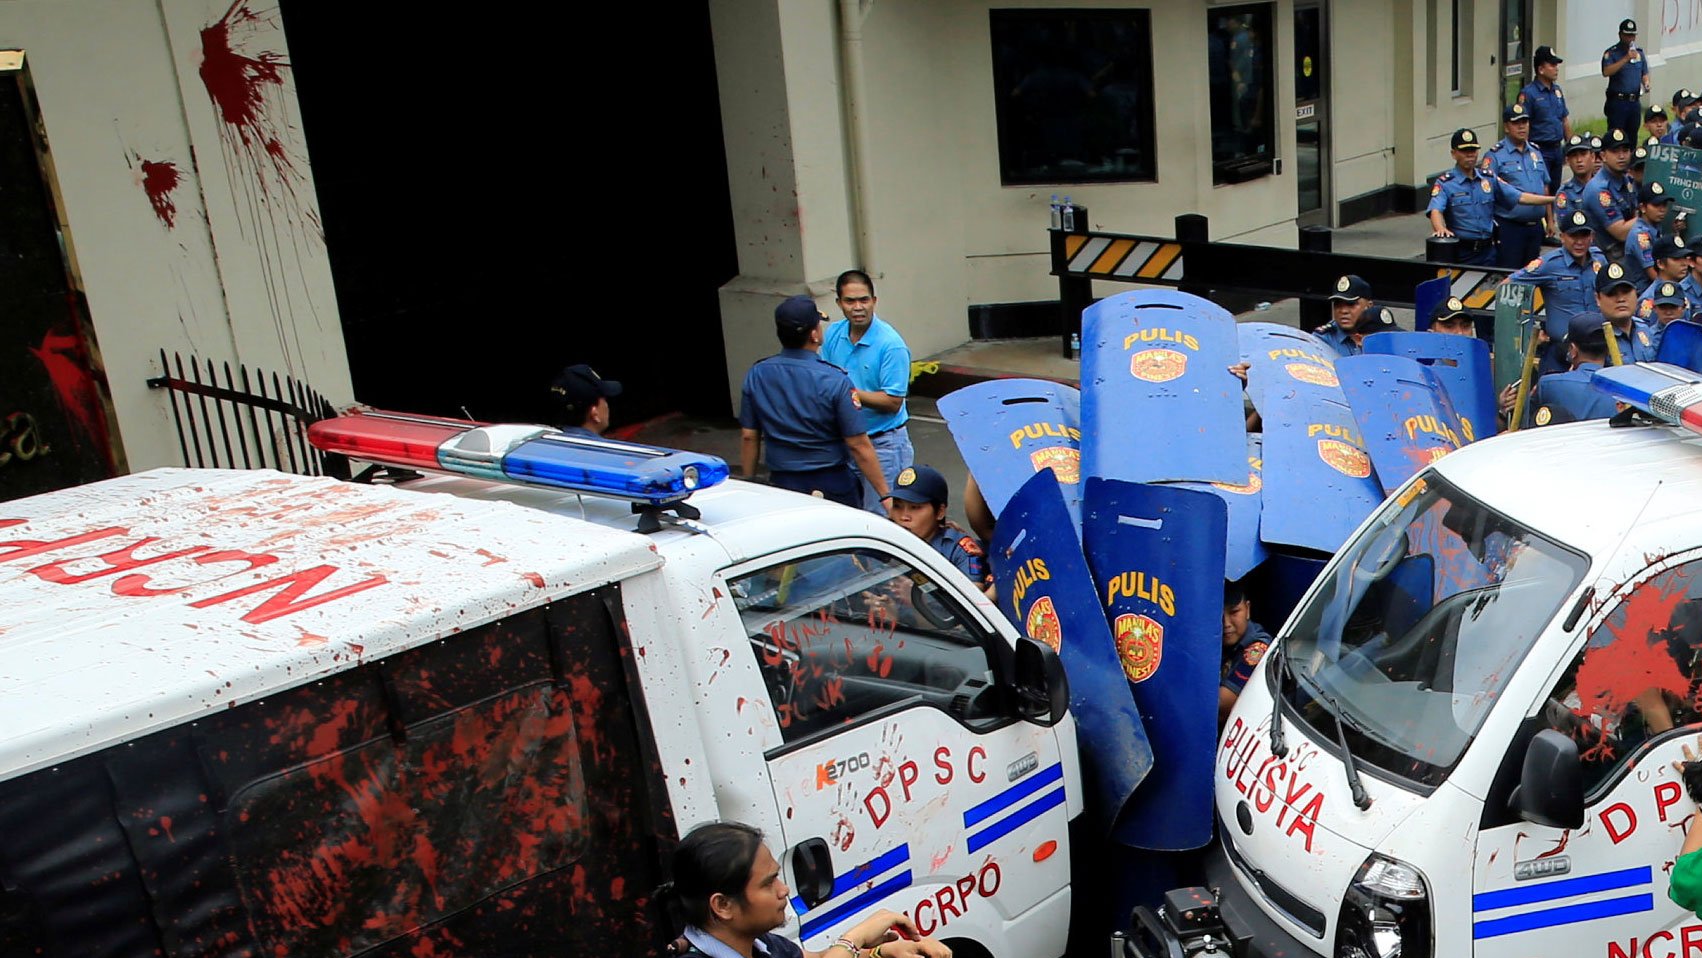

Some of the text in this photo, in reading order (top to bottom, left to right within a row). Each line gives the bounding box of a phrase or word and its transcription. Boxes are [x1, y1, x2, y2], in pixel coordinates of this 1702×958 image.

[1123, 328, 1200, 351] PULIS
[1012, 557, 1050, 622] PULIS
[1107, 571, 1177, 617] PULIS
[1219, 717, 1325, 853] PULISYA
